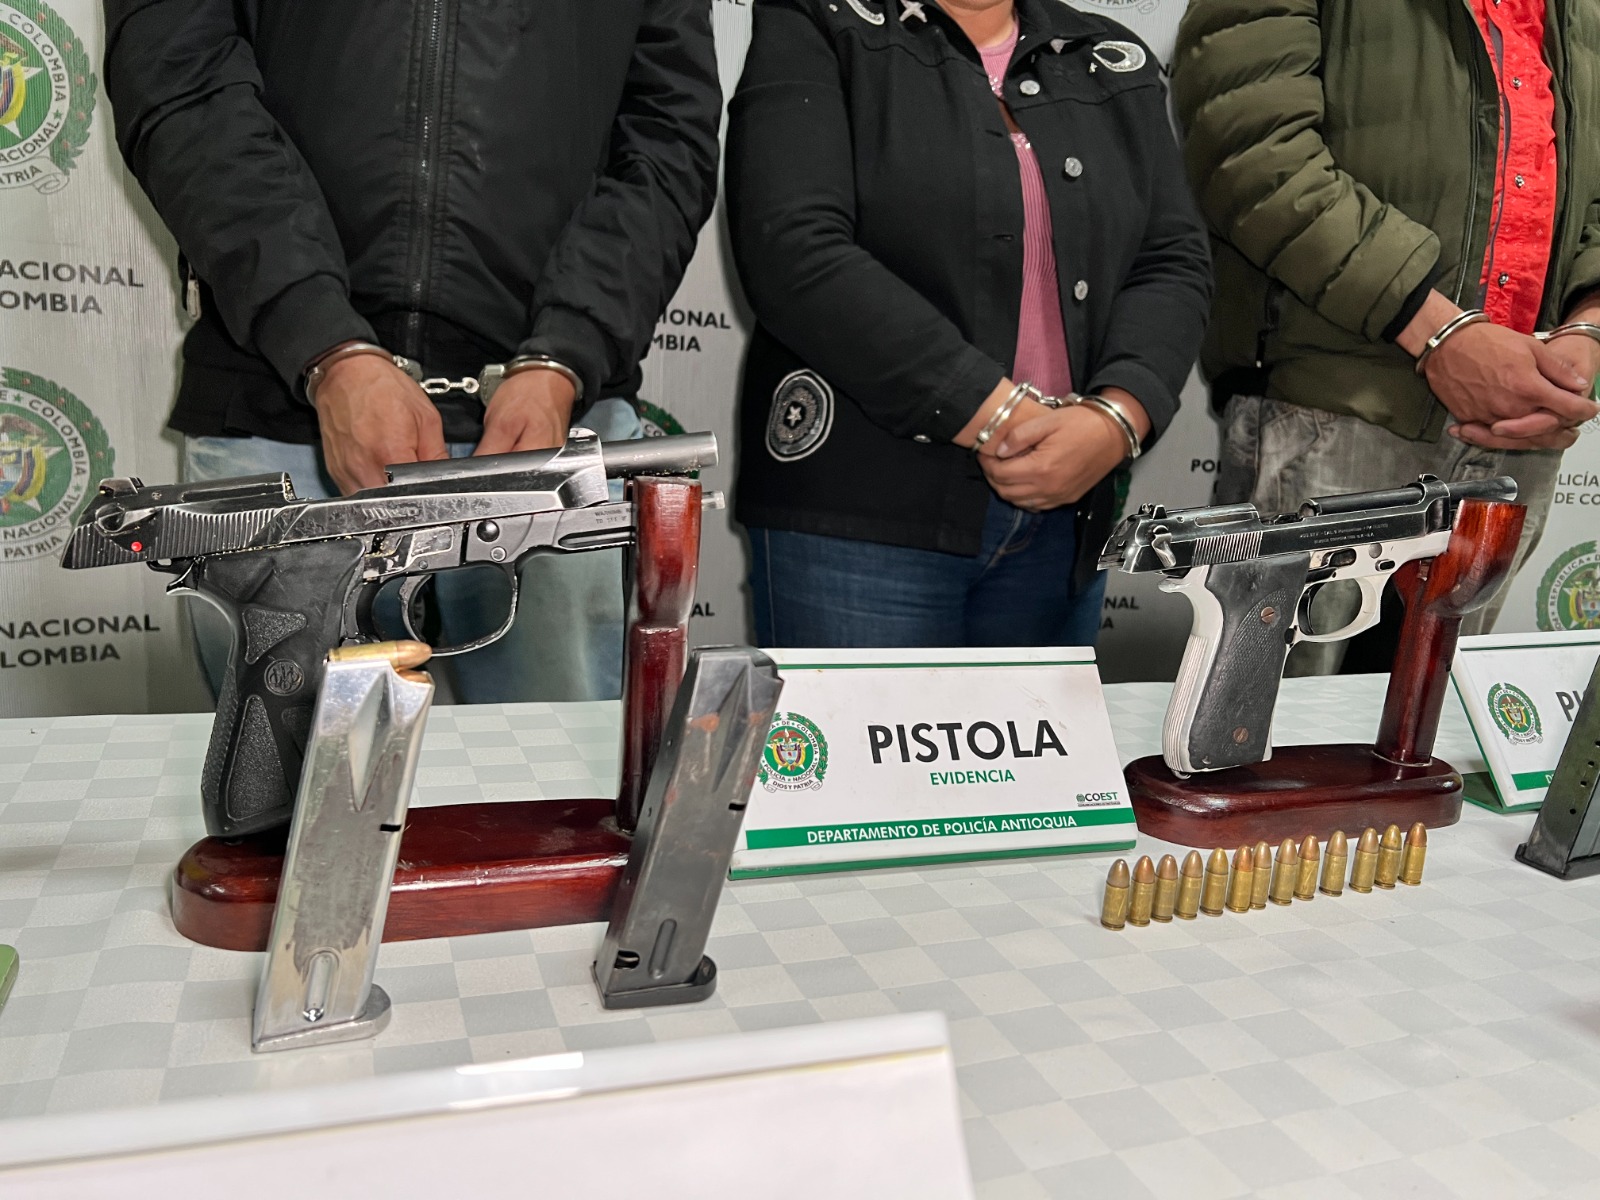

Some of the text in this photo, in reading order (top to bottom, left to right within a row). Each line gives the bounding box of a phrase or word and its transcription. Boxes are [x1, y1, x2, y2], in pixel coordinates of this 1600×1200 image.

[8, 12, 67, 102] COLOMBIA
[0, 118, 60, 163] ACIONAL
[0, 165, 43, 184] TRIA
[0, 259, 144, 288] ACIONAL
[0, 290, 103, 315] OMBIA
[662, 308, 732, 330] IONAL
[29, 399, 87, 477] COLOMBIA
[1558, 471, 1600, 488] LICÍA
[1554, 492, 1576, 505] DE
[2, 493, 80, 540] NACIONAL
[4, 535, 63, 558] PATRIA
[0, 643, 121, 669] LOMBIA
[868, 719, 1069, 764] PISTOLA
[930, 769, 1016, 786] EVIDENCIA
[1084, 791, 1118, 802] COEST
[807, 815, 1077, 844] DEPARTAMENTO DE POLICÍA ANTIOQUIA
